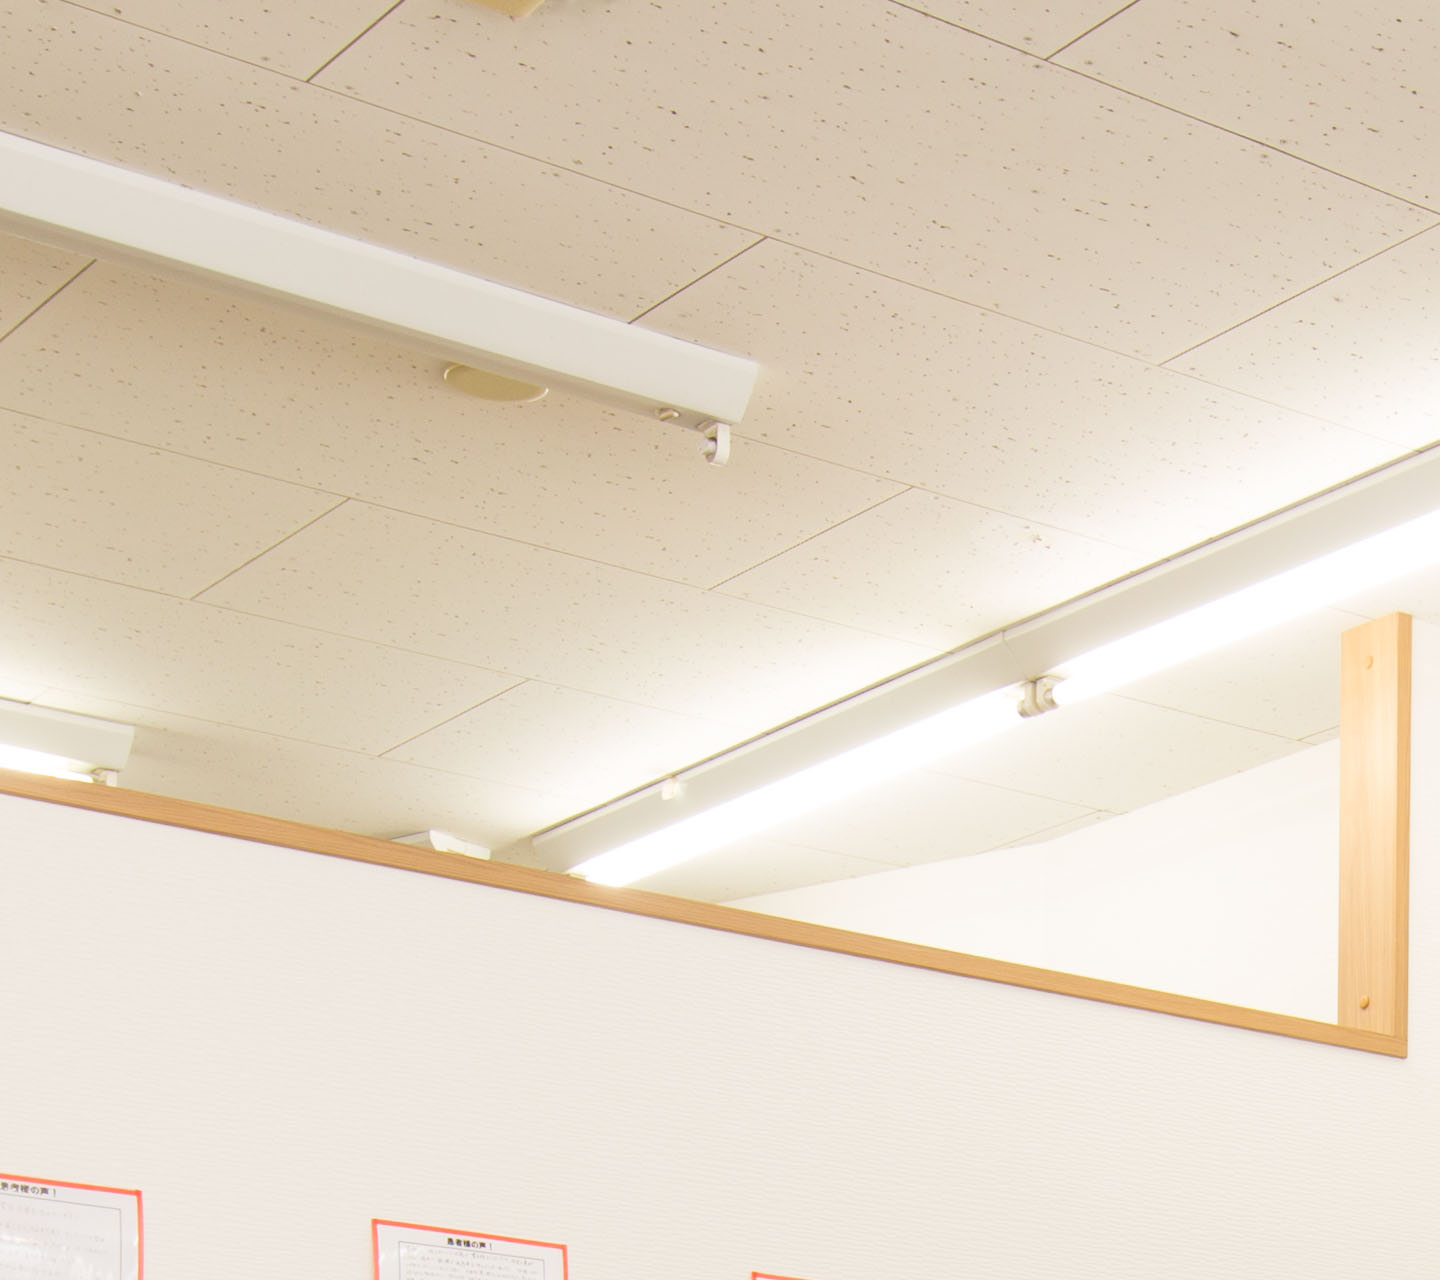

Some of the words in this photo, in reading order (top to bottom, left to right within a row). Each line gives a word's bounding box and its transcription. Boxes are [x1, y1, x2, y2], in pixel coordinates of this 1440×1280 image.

[0, 1182, 57, 1198] 患者様の声！
[447, 1237, 493, 1251] 患者様の声！
